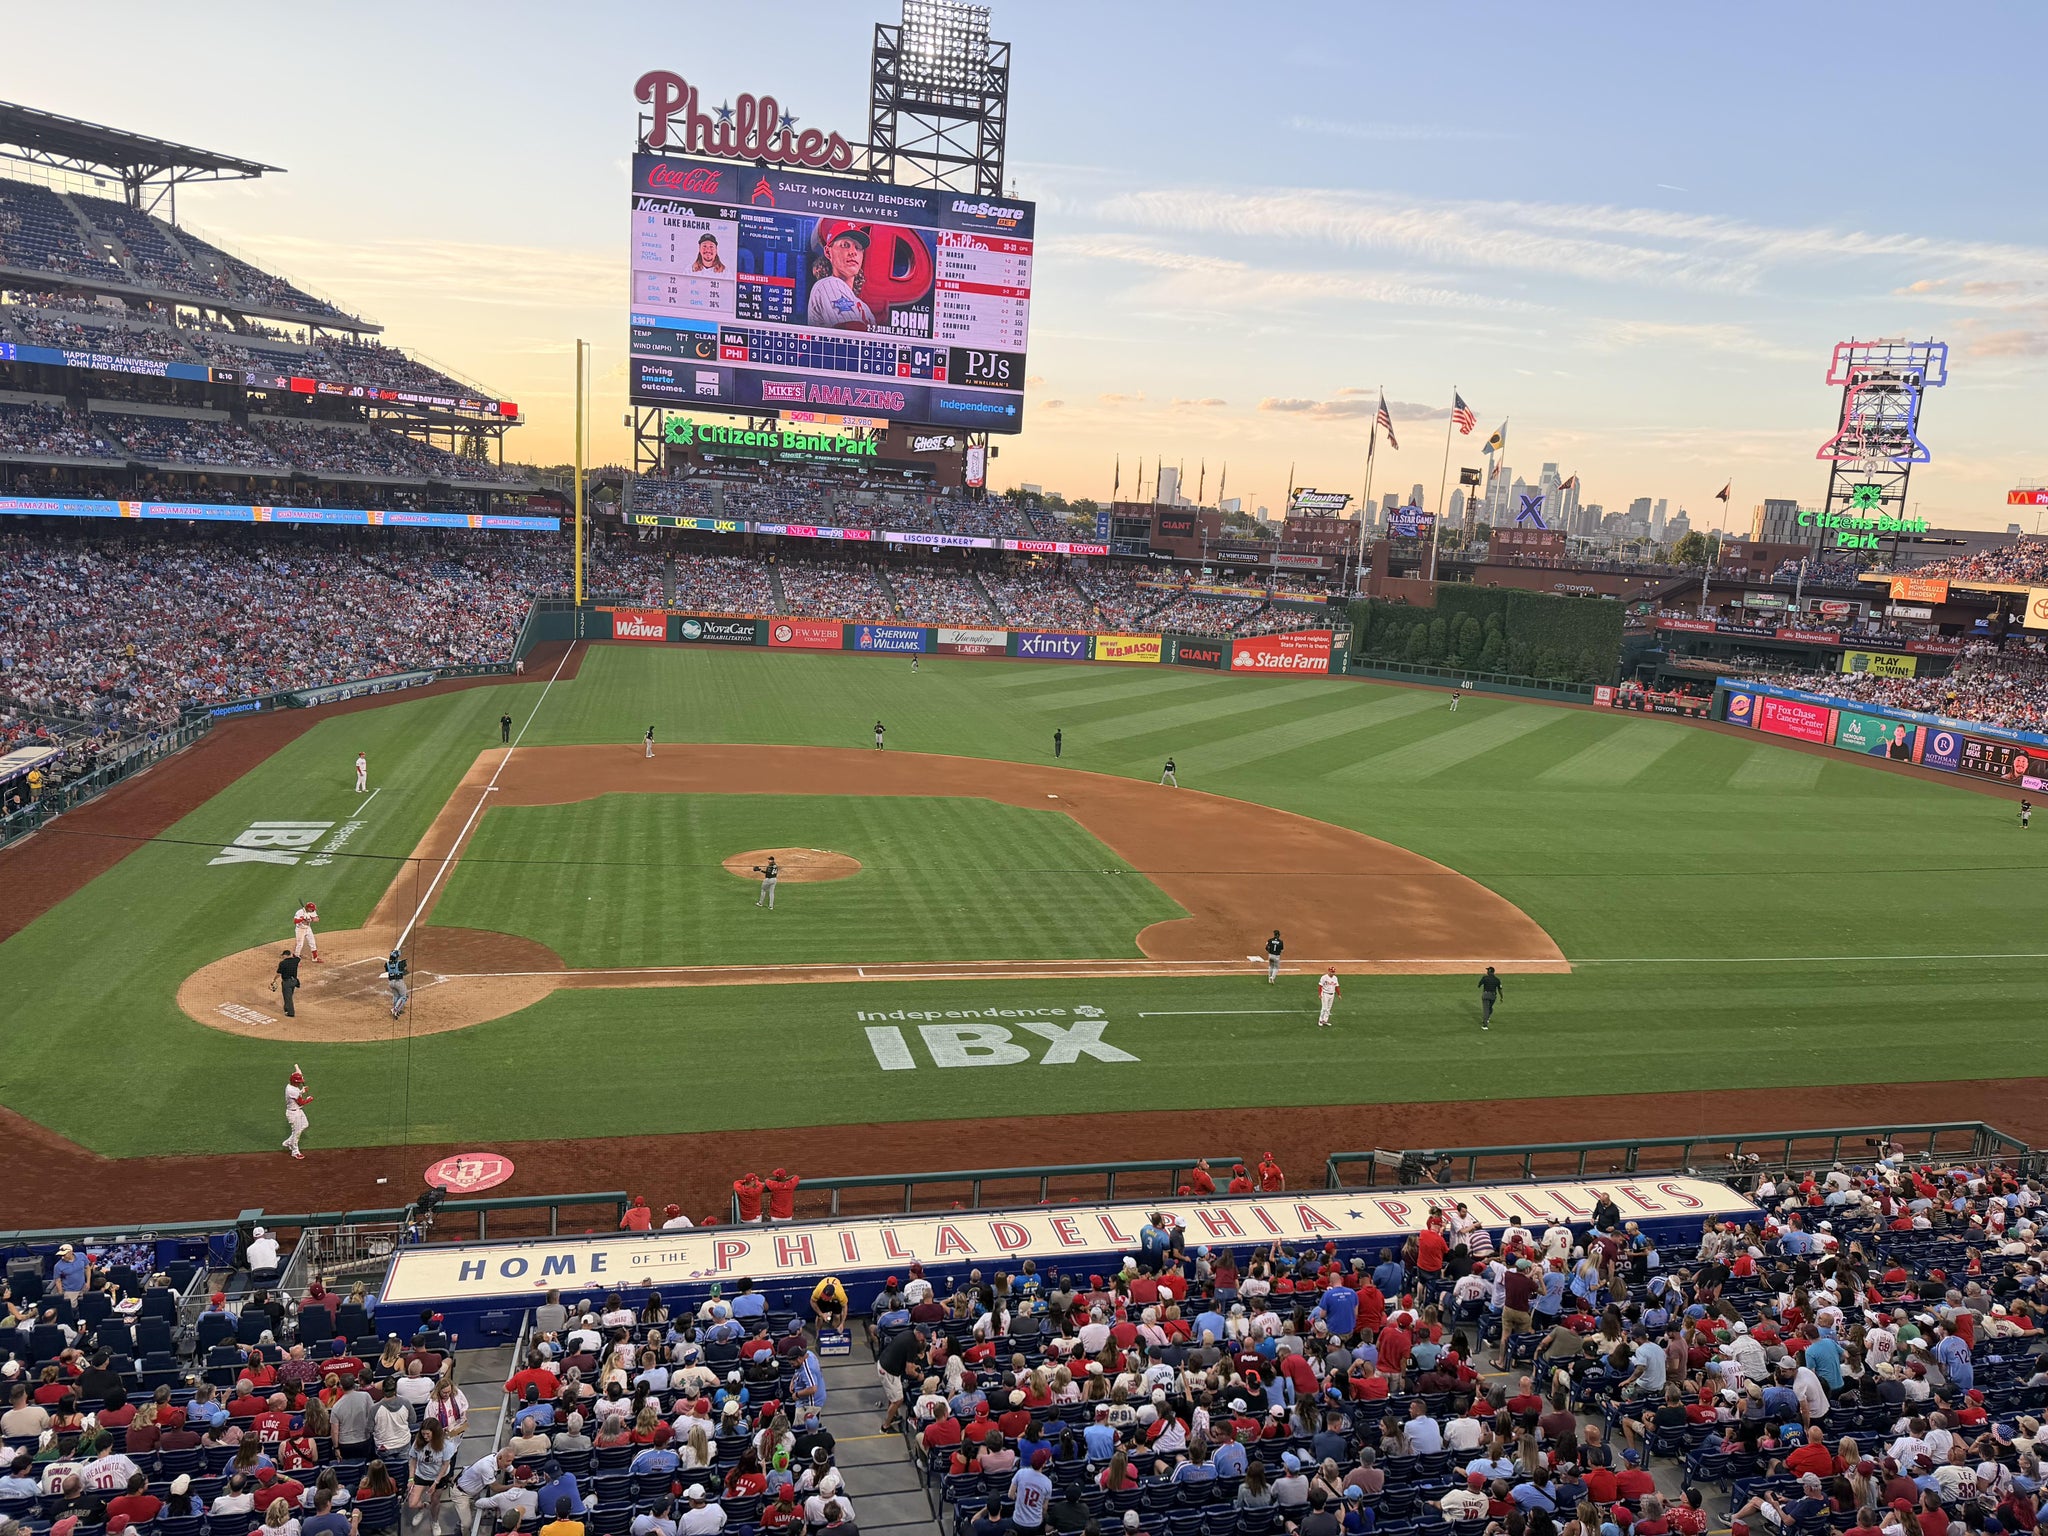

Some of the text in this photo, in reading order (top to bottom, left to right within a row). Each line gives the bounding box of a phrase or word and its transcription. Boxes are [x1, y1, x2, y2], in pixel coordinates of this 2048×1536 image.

[634, 69, 853, 170] Phillies
[648, 163, 723, 195] Coca-Cola
[779, 183, 927, 208] SALTZ MONGELUZZI BENDESKY
[637, 198, 695, 216] Marlins
[807, 200, 899, 218] INJURY LAWYERS
[952, 200, 1024, 220] theScore
[663, 218, 681, 228] LAKE
[683, 220, 710, 230] BACHAR
[936, 231, 989, 251] Phillies
[912, 305, 930, 313] ALEC
[891, 310, 929, 329] BOHM
[695, 333, 716, 341] CLEAR
[724, 334, 743, 345] MIA
[633, 342, 672, 352] WIND (MPH)
[726, 348, 743, 359] PHI
[914, 351, 930, 366] 0-1
[63, 350, 169, 370] HAPPY 53RD ANNIVERSARY
[965, 350, 1010, 380] PJs
[66, 358, 166, 377] JOHN AND RITA GREAVES
[642, 365, 672, 377] Driving
[218, 372, 233, 380] 8:10
[641, 374, 675, 384] smarter
[353, 386, 364, 397] 10
[641, 383, 685, 393] outcomes.
[768, 385, 801, 397] MIKE'S
[397, 392, 418, 402] GAME
[418, 394, 433, 404] DAY
[432, 396, 456, 407] READY.
[808, 383, 905, 412] AMAZING
[940, 399, 1004, 413] Independence
[698, 423, 878, 456] Citizens Bank Park
[914, 435, 947, 452] GHOST
[1297, 489, 1345, 503] Fitzpatrick
[18, 502, 59, 510] AMAZING
[167, 507, 202, 515] AMAZING
[635, 514, 659, 526] UKG
[675, 517, 698, 528] UKG
[714, 520, 736, 531] UKG
[1161, 520, 1191, 530] GIANT
[1400, 514, 1415, 524] STAR
[1416, 515, 1434, 525] GAME
[1877, 516, 1927, 532] Bank
[789, 526, 815, 536] NECA
[847, 529, 870, 539] NECA
[903, 534, 974, 546] LISCIO'S BAKERY
[1020, 541, 1053, 551] TOYOTA
[1837, 532, 1879, 549] Park
[1072, 544, 1104, 553] TOYOTA
[1566, 584, 1594, 592] TOYOTA
[1908, 584, 1946, 593] MONGELUZZI
[1908, 590, 1937, 598] BENDESKY
[662, 609, 700, 617] ASPLUNDH
[616, 621, 663, 637] Wawa
[702, 621, 754, 635] NovaCare
[1674, 621, 1709, 630] Budweiser
[811, 629, 838, 639] WEBB
[875, 628, 918, 640] SHERWIN
[951, 631, 993, 644] Yuengling
[1795, 632, 1833, 642] Budweiser
[873, 638, 920, 650] WILLIAMS.
[957, 645, 986, 653] LAGER
[1021, 635, 1081, 655] xfinity
[1106, 643, 1159, 657] W.B.MASON
[1179, 648, 1221, 662] GIANT
[1875, 656, 1900, 666] PLAY
[1885, 665, 1909, 676] WIN!
[1655, 705, 1677, 713] TOYOTA
[1777, 704, 1816, 719] Fox Chase
[1883, 708, 1911, 718] Independence
[1776, 714, 1824, 729] Cancer Center
[1788, 724, 1823, 737] Temple Health
[1980, 726, 2012, 737] Independence
[1967, 743, 1981, 751] PITCH
[1926, 753, 1957, 764] ROTHMAN
[1986, 751, 1993, 760] 12
[2001, 755, 2008, 764] 17
[207, 821, 336, 865] IBX
[857, 1005, 1066, 1022] Independence
[864, 1020, 1141, 1070] IBX
[1560, 1236, 1567, 1248] 3
[459, 1251, 608, 1281] HOME
[631, 1255, 654, 1265] OF
[659, 1251, 689, 1264] THE
[1110, 1409, 1133, 1421] #81
[1910, 1445, 1932, 1454] HARPER
[48, 1467, 71, 1477] HOWARD
[86, 1462, 119, 1480] REALMUTO
[1957, 1471, 1972, 1479] LEE
[95, 1474, 114, 1489] 10
[1023, 1487, 1041, 1508] 12
